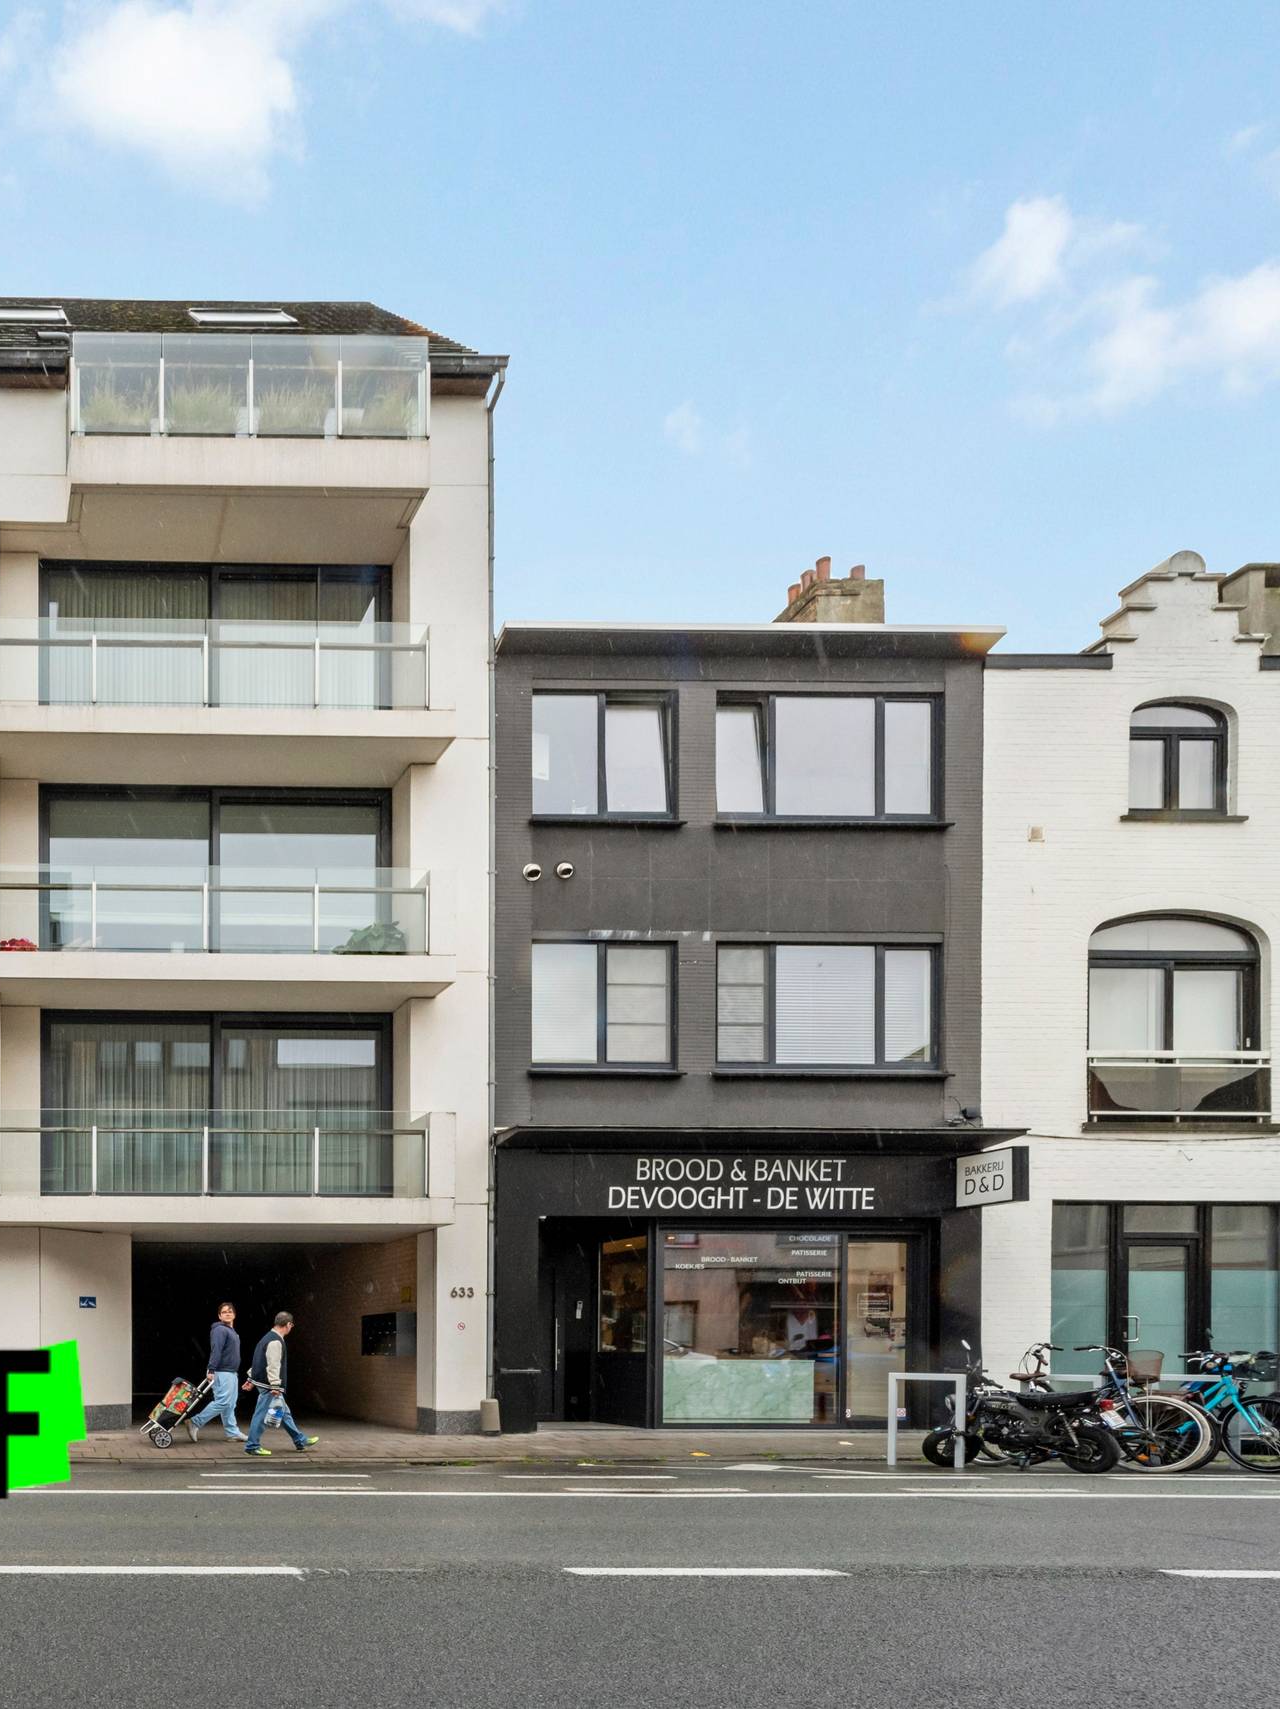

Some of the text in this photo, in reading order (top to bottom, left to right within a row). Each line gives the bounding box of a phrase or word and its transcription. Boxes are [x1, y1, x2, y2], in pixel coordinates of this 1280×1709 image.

[636, 1158, 847, 1182] BROOD & BANKET
[964, 1160, 1004, 1177] BAKKERIJ
[964, 1173, 1005, 1196] D & D
[608, 1186, 749, 1209] DEVOOGHT
[766, 1187, 799, 1210] DE
[805, 1187, 875, 1210] WITTE
[788, 1234, 832, 1243] CHOCOLADE
[791, 1249, 828, 1257] PATISSERIE
[700, 1256, 726, 1264] BROOD
[730, 1256, 759, 1264] BANKET
[796, 1271, 832, 1279] PATISSERIE
[450, 1286, 475, 1298] 633
